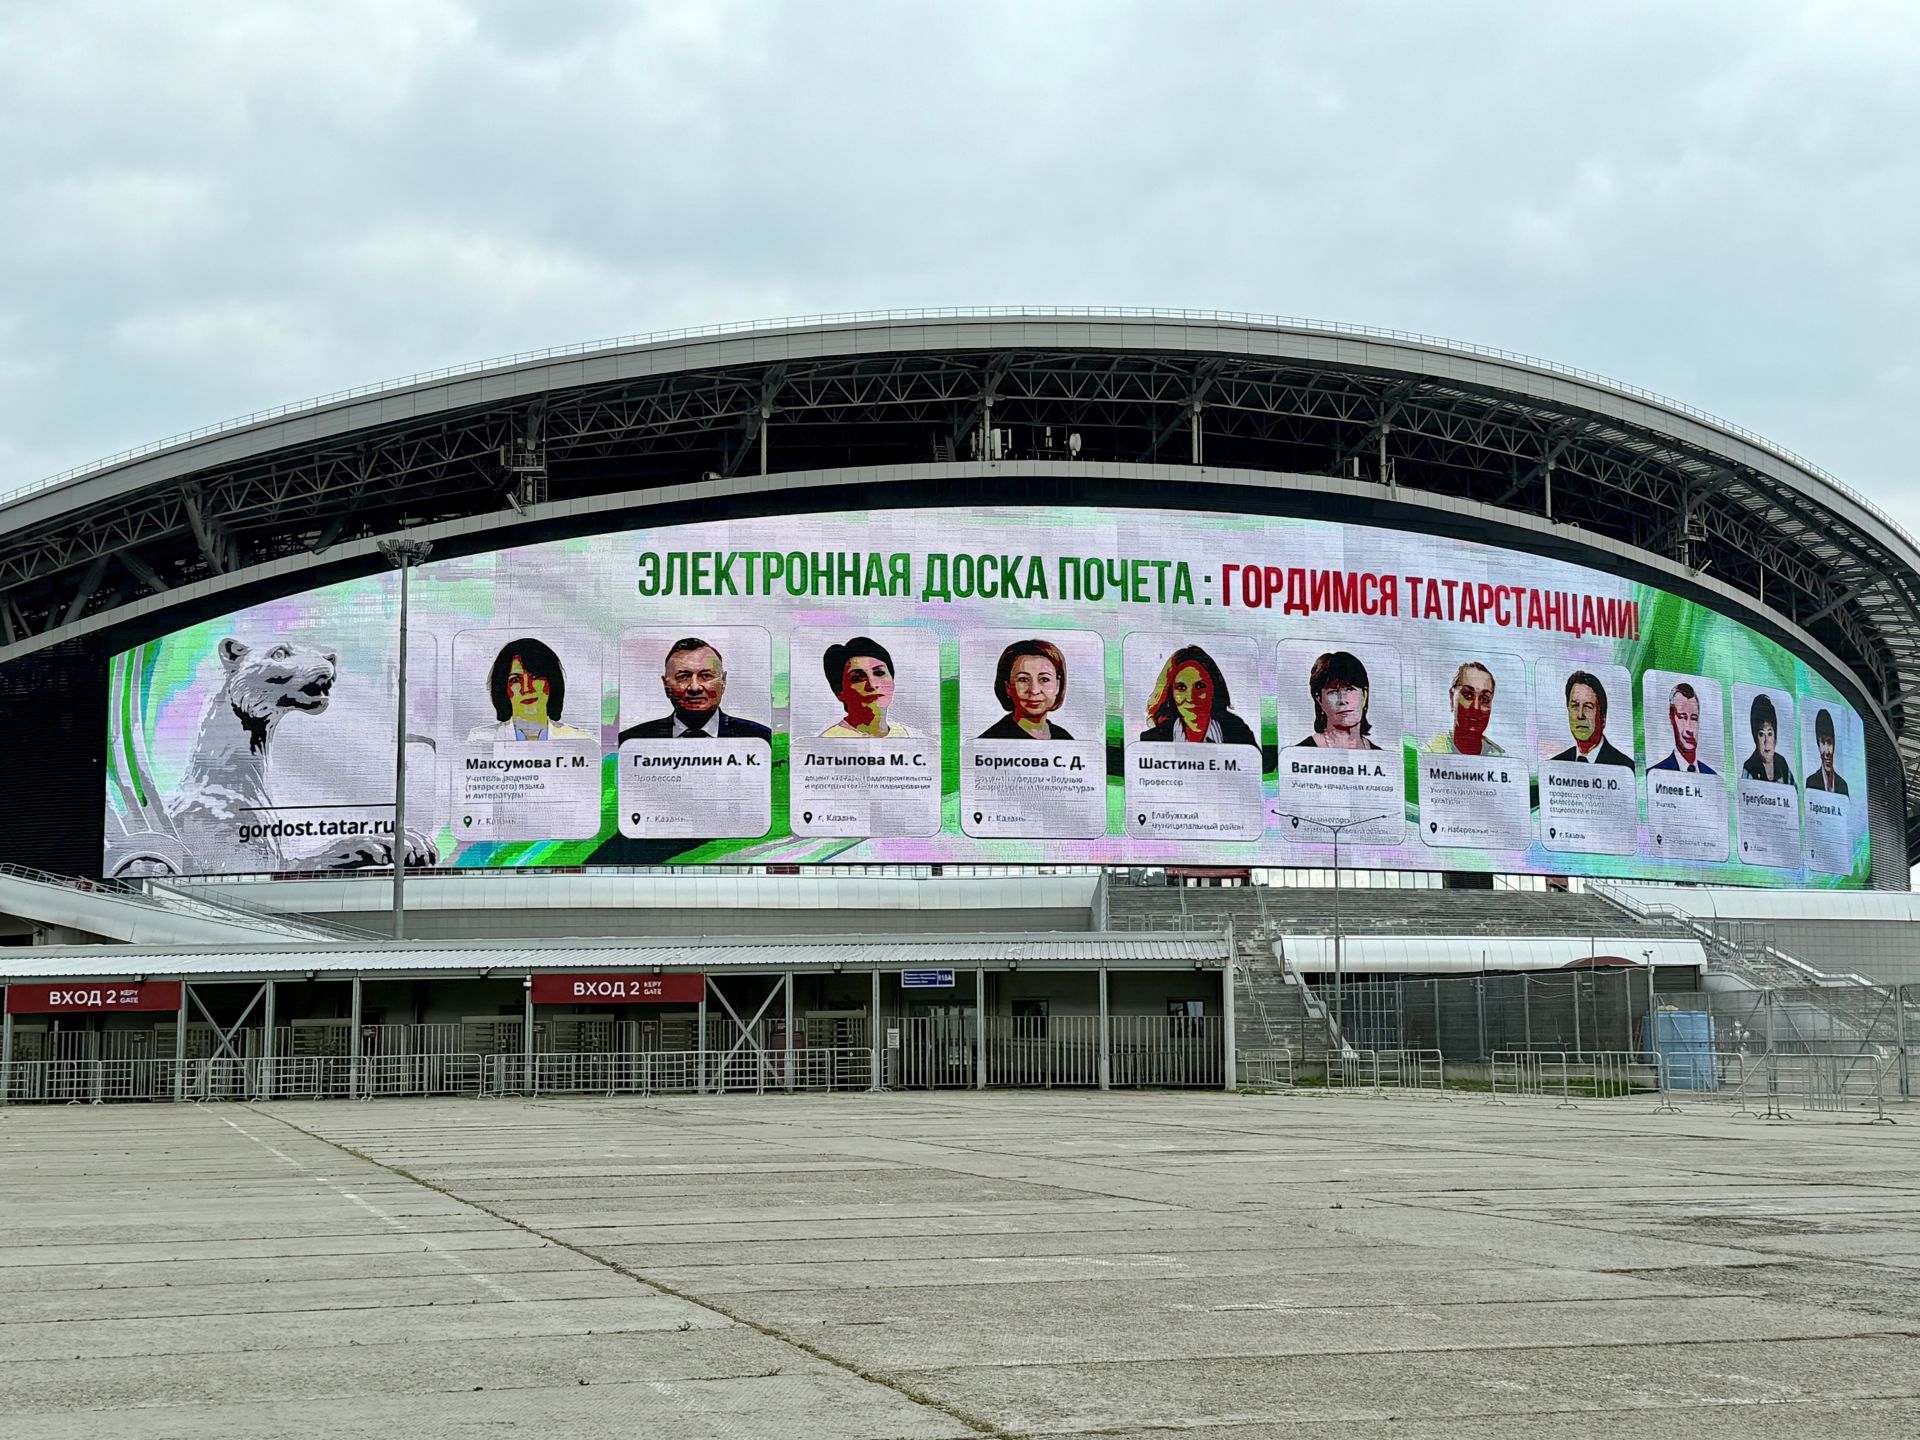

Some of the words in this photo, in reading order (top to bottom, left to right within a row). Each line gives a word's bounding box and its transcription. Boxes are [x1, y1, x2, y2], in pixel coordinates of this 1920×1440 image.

[638, 550, 911, 597] ЭЛЕКТРОННАЯ
[921, 553, 1048, 603] ДОСКА
[1222, 563, 1398, 617] ГОРДИМСЯ
[1405, 576, 1640, 641] ТАТАРСТАНЦАМИ!
[466, 758, 552, 772] Максумова
[555, 756, 567, 768] Г.
[572, 756, 589, 768] М.
[634, 754, 722, 769] Галиуллин
[727, 753, 742, 766] А.
[746, 753, 761, 766] К.
[804, 753, 885, 766] Латыпова
[890, 753, 909, 766] М.
[913, 753, 927, 766] С.
[975, 754, 1049, 769] Борисова
[1053, 755, 1066, 768] С.
[1070, 755, 1085, 771] Д.
[1138, 757, 1205, 770] Шастина
[1209, 759, 1220, 771] Е.
[1225, 759, 1241, 772] М.
[1291, 761, 1354, 775] Ваганова
[1358, 764, 1371, 776] Н.
[1374, 765, 1386, 777] А.
[1429, 768, 1485, 782] Мельник
[1487, 771, 1498, 783] К.
[1501, 772, 1512, 783] В.
[1549, 774, 1590, 789] Комлев
[1592, 777, 1605, 790] Ю.
[1607, 779, 1621, 791] Ю.
[238, 819, 395, 843] gordost.tatar.ru
[573, 981, 625, 997] ВХОД
[629, 981, 640, 995] 2
[49, 990, 102, 1006] ВХОД
[105, 990, 117, 1004] 2
[119, 996, 139, 1004] GATE
